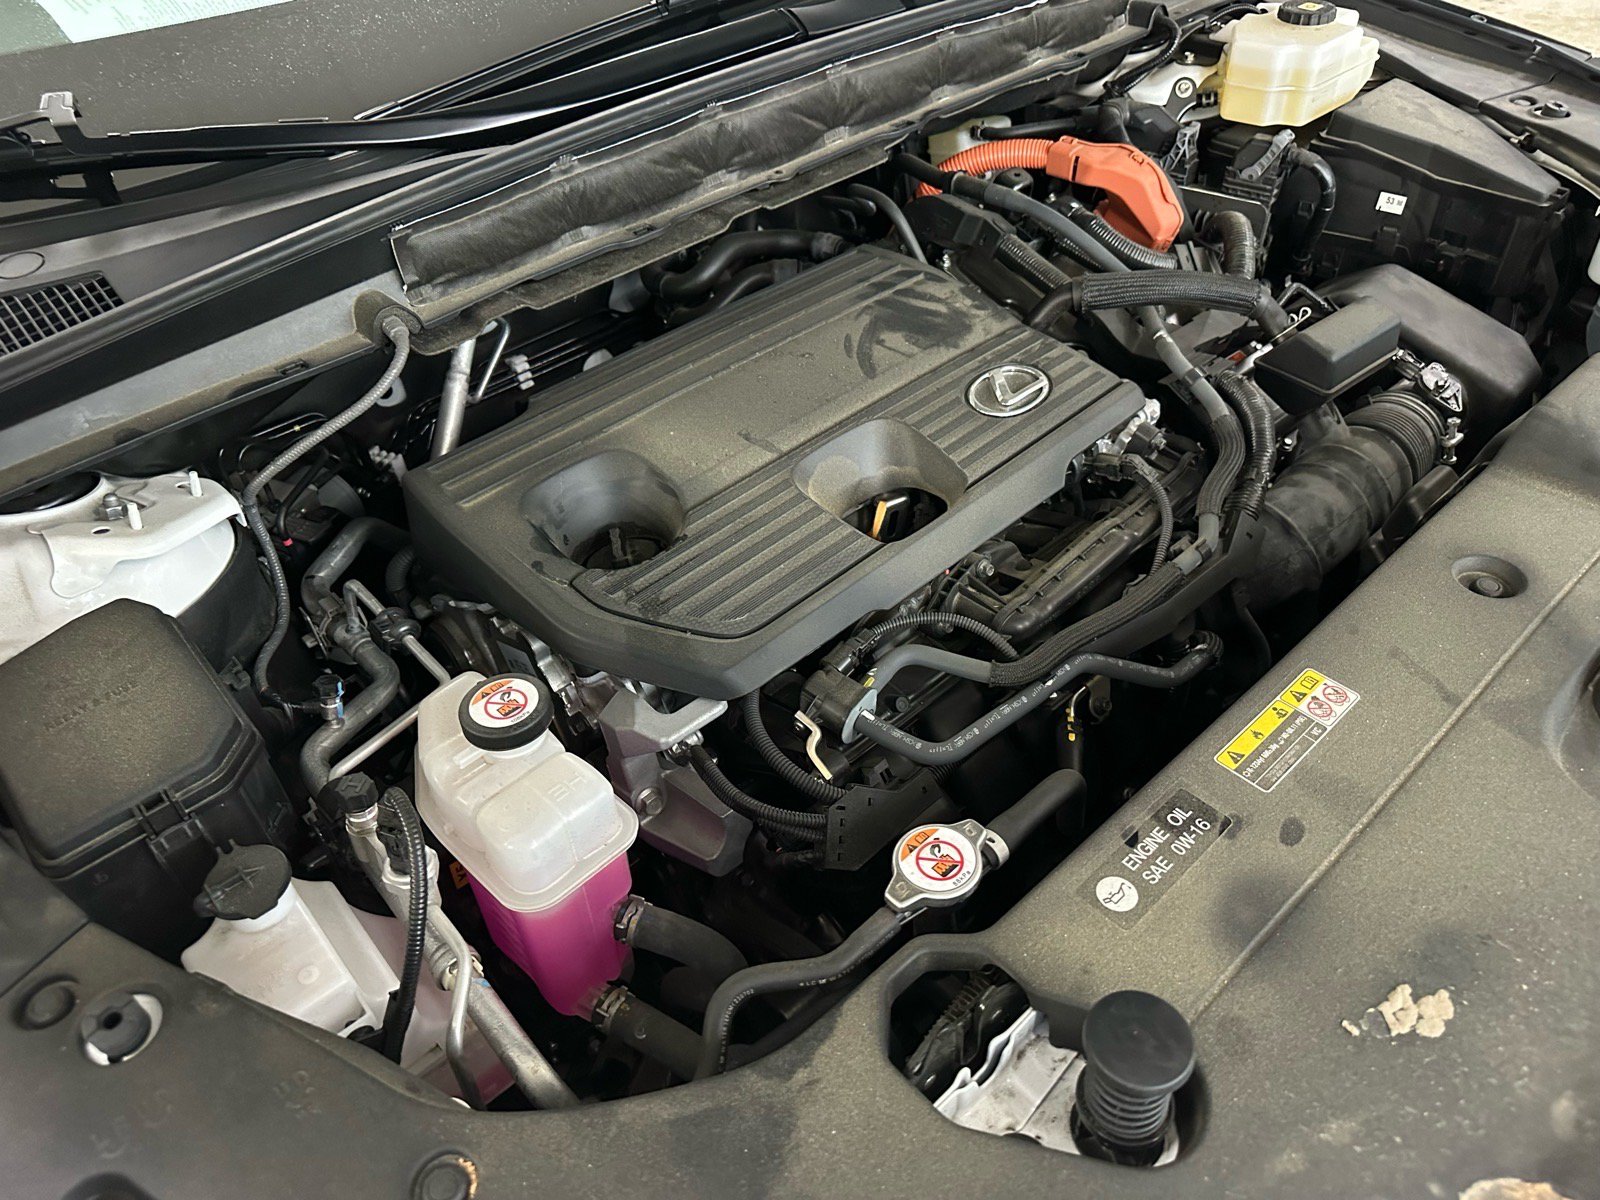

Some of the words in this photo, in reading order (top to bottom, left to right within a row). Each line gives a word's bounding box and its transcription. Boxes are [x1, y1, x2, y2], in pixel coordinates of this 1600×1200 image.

[1121, 826, 1170, 871] ENGINE
[1166, 807, 1193, 826] OIL
[1142, 855, 1174, 884] SAE
[1170, 818, 1211, 855] 0W-16
